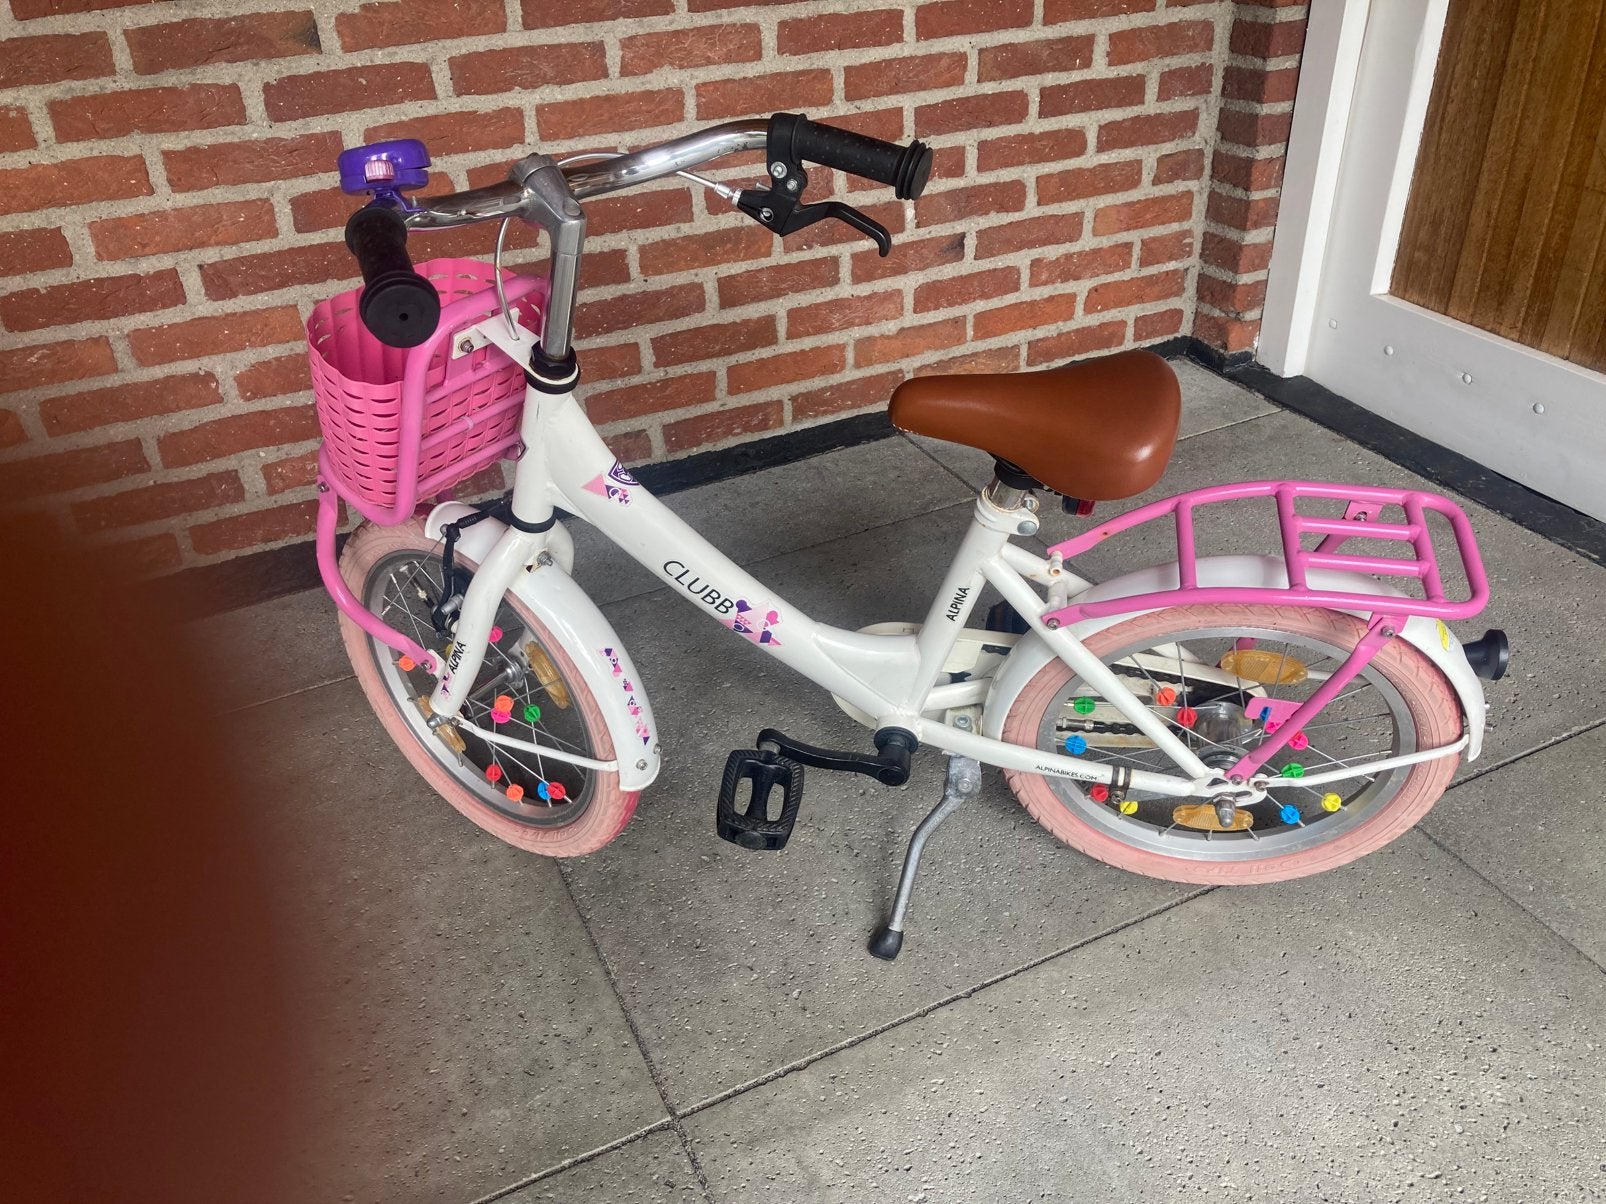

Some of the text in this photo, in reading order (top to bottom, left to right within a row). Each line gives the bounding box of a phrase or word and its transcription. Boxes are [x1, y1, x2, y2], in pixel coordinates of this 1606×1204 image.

[663, 560, 735, 614] CLUBB
[945, 587, 970, 622] ALPINA
[448, 640, 467, 675] ALPINA
[1035, 765, 1098, 781] ALPINABIKES.COM
